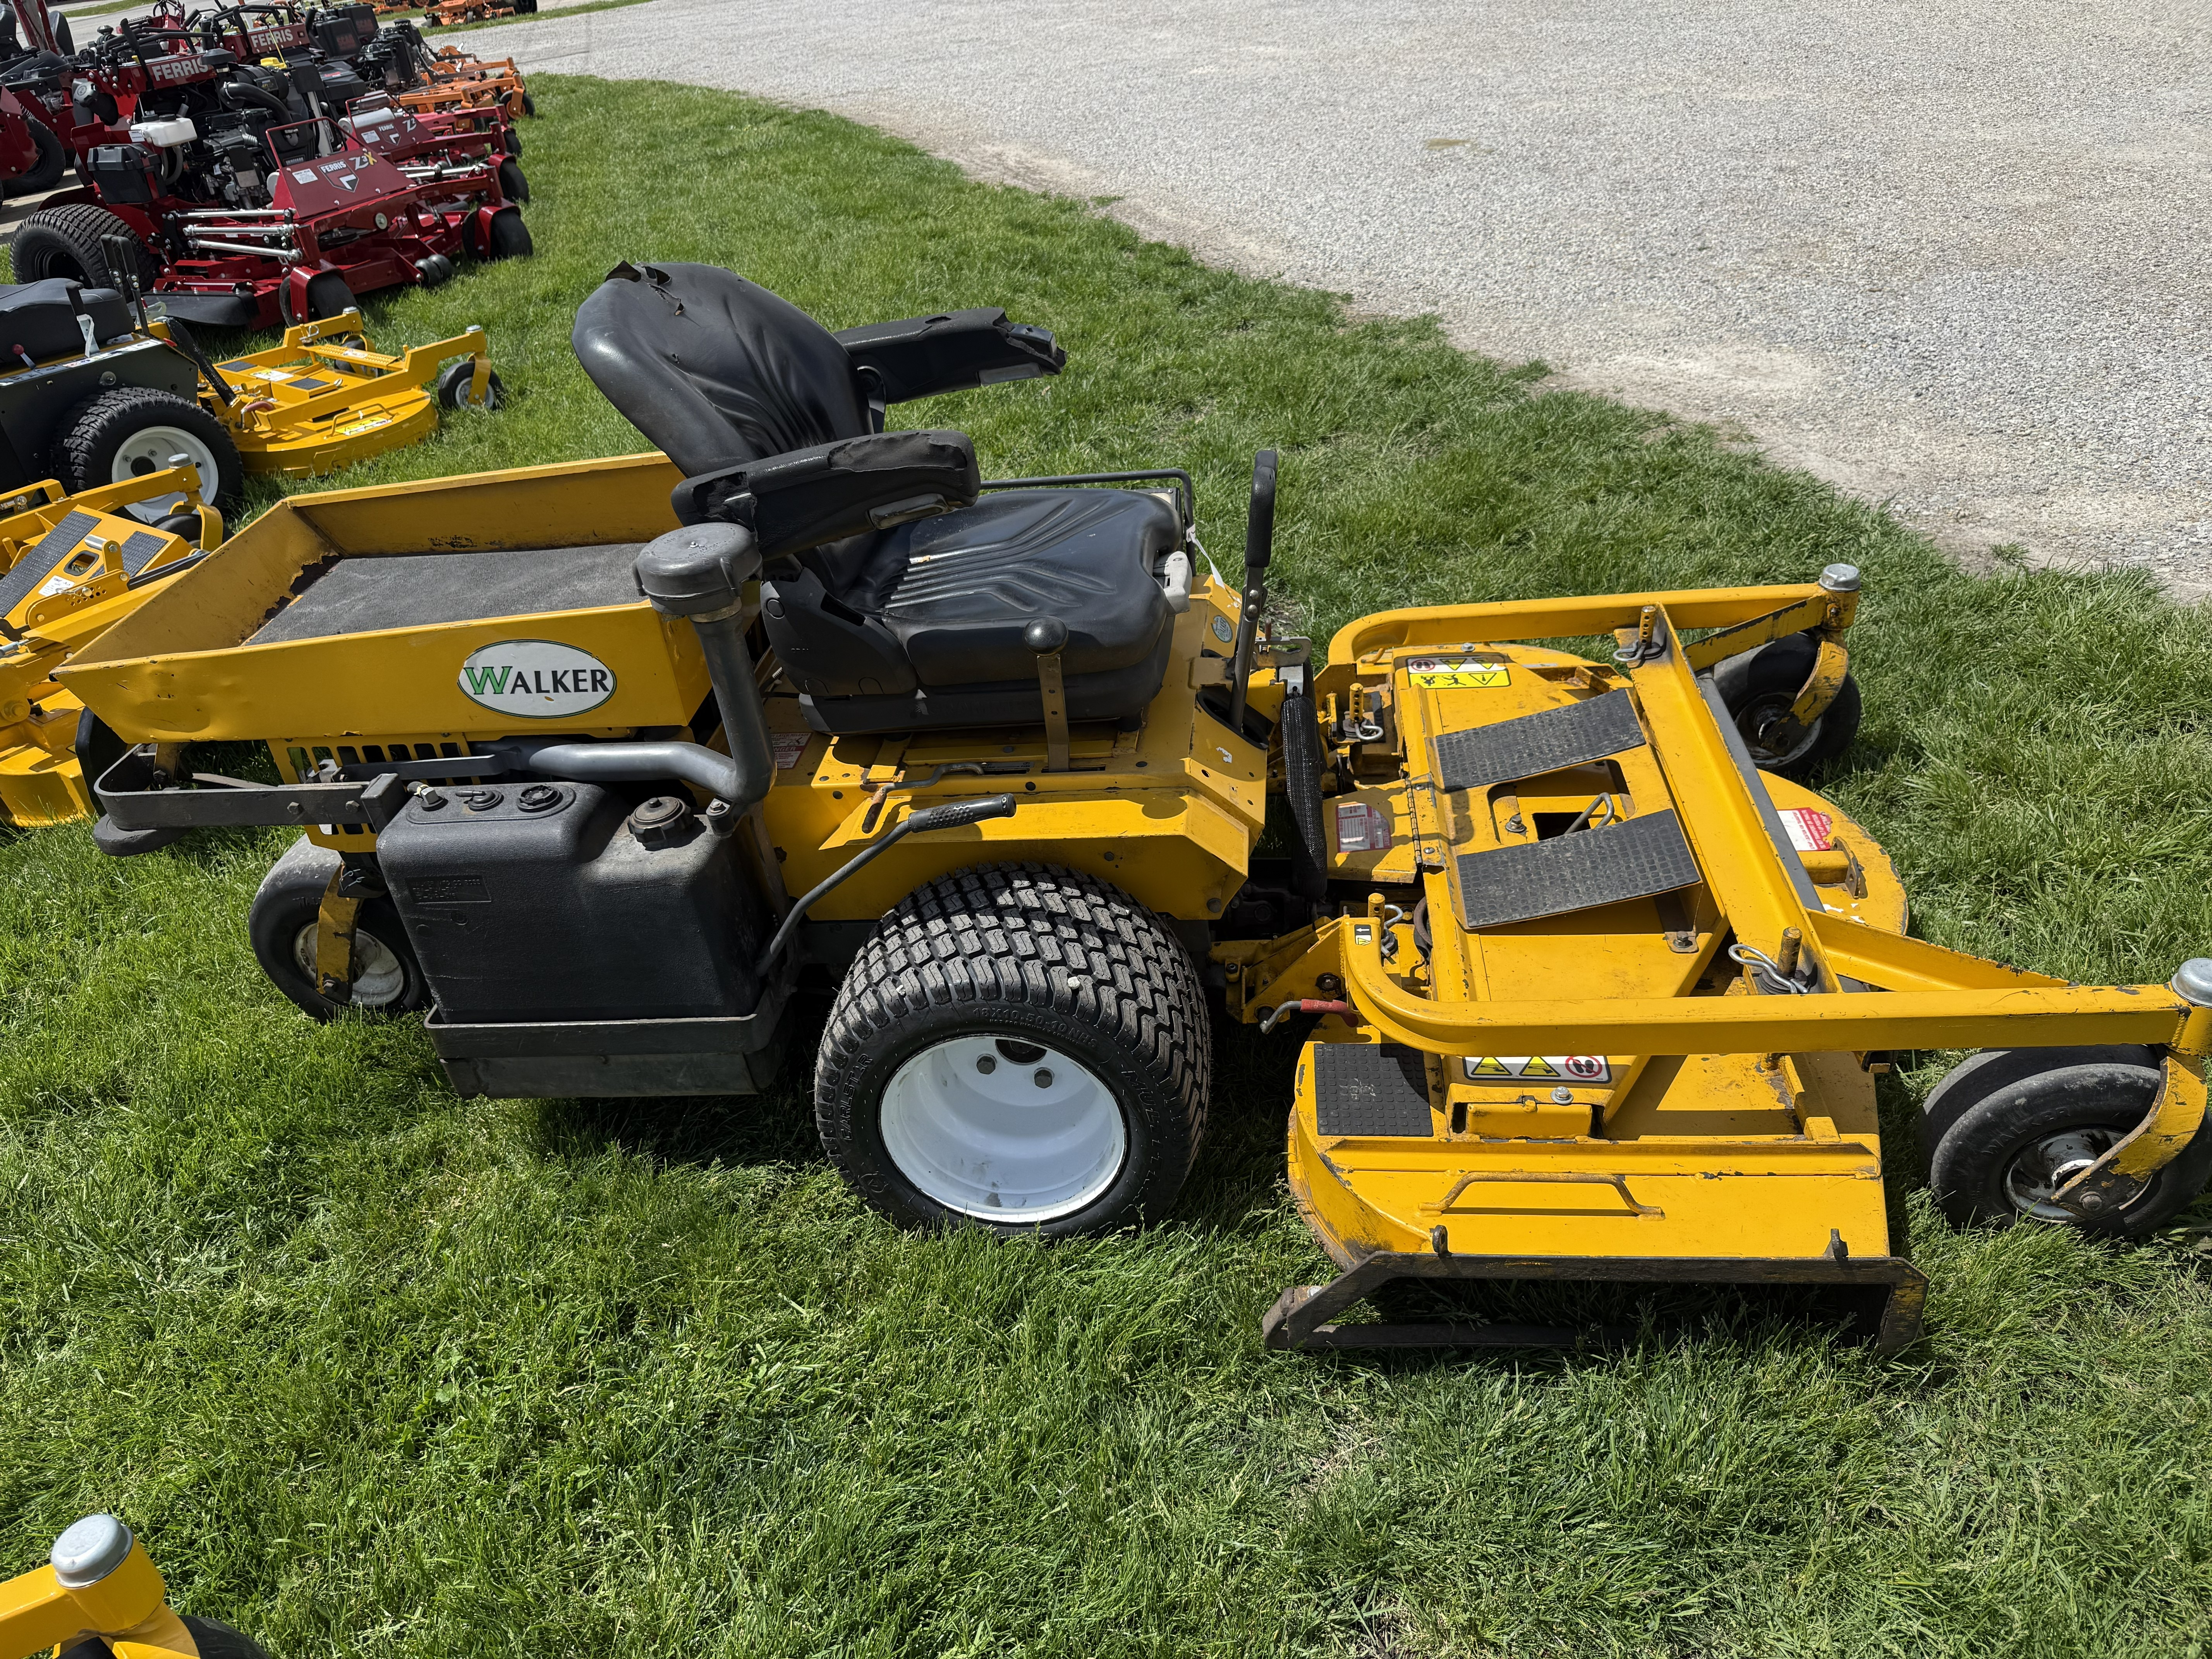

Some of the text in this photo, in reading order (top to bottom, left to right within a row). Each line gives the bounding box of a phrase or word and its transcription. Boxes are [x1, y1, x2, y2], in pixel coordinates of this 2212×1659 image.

[251, 29, 293, 47] FERRIS
[152, 57, 208, 81] FERRIS
[320, 161, 347, 173] FERRIS
[463, 666, 610, 695] WALKER
[839, 1053, 873, 1141] CARLSTAR
